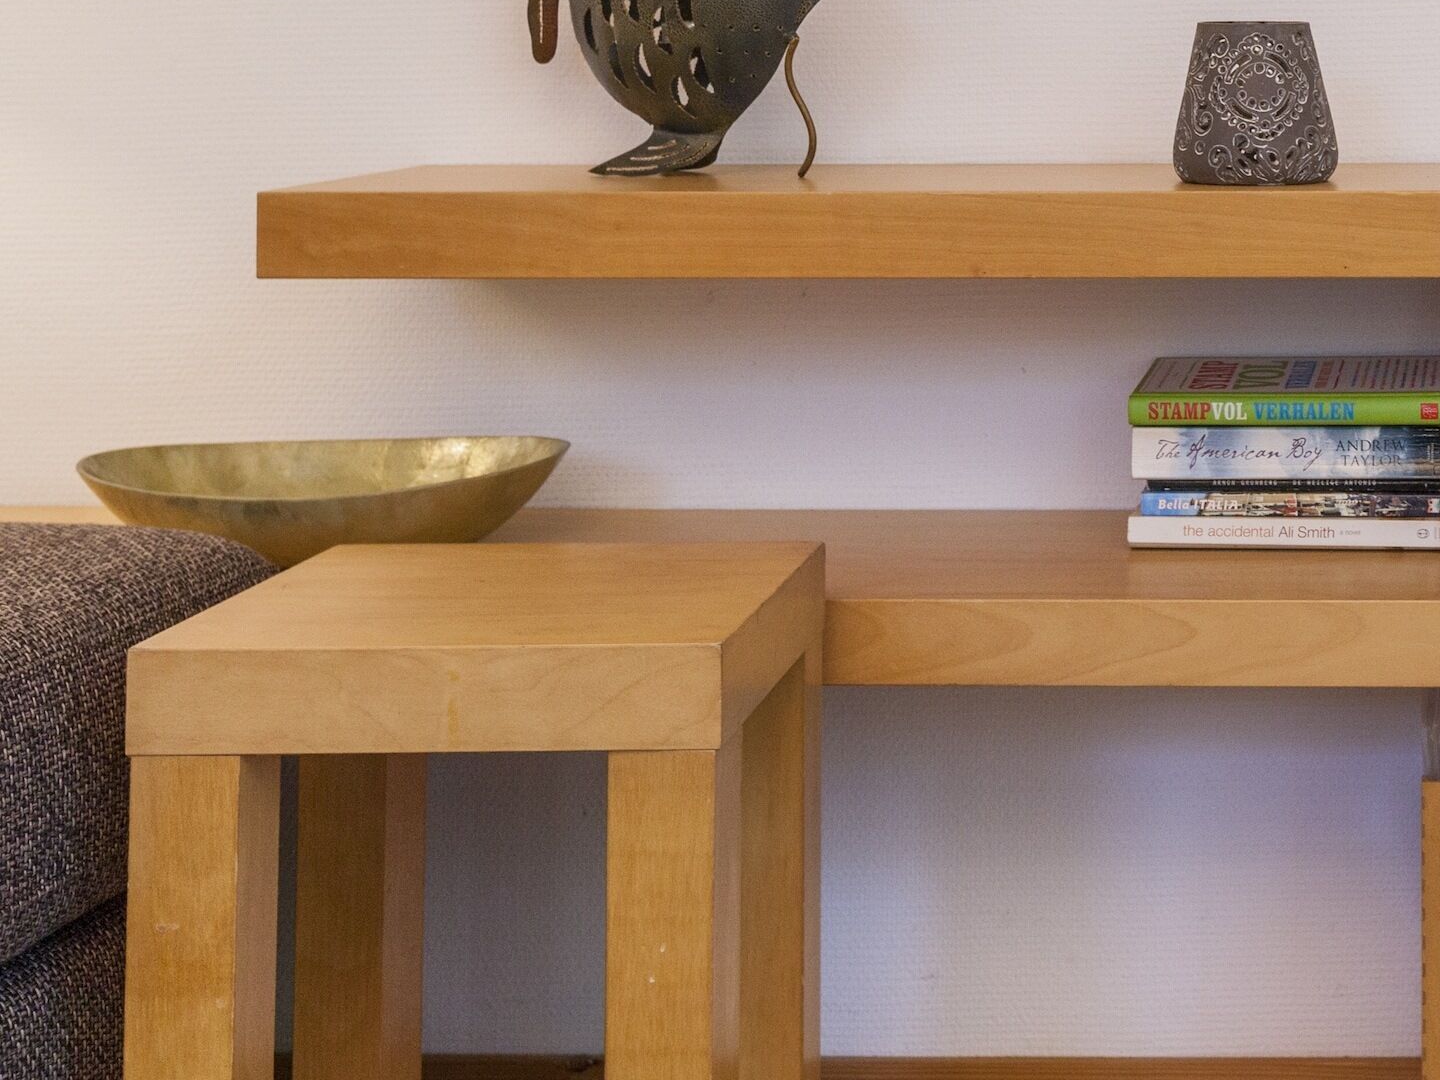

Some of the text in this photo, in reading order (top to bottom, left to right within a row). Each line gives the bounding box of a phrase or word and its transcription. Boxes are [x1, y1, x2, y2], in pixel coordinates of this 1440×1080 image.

[1253, 401, 1356, 421] VERHALEN
[1336, 440, 1408, 452] ANDREW
[1155, 434, 1323, 471] The American Boy
[1340, 454, 1402, 466] TAYLOR
[1158, 498, 1238, 510] Bella ITALIA
[1183, 525, 1204, 537] the
[1208, 525, 1274, 538] accidental
[1278, 526, 1294, 538] Ali
[1297, 526, 1335, 538] Smith
